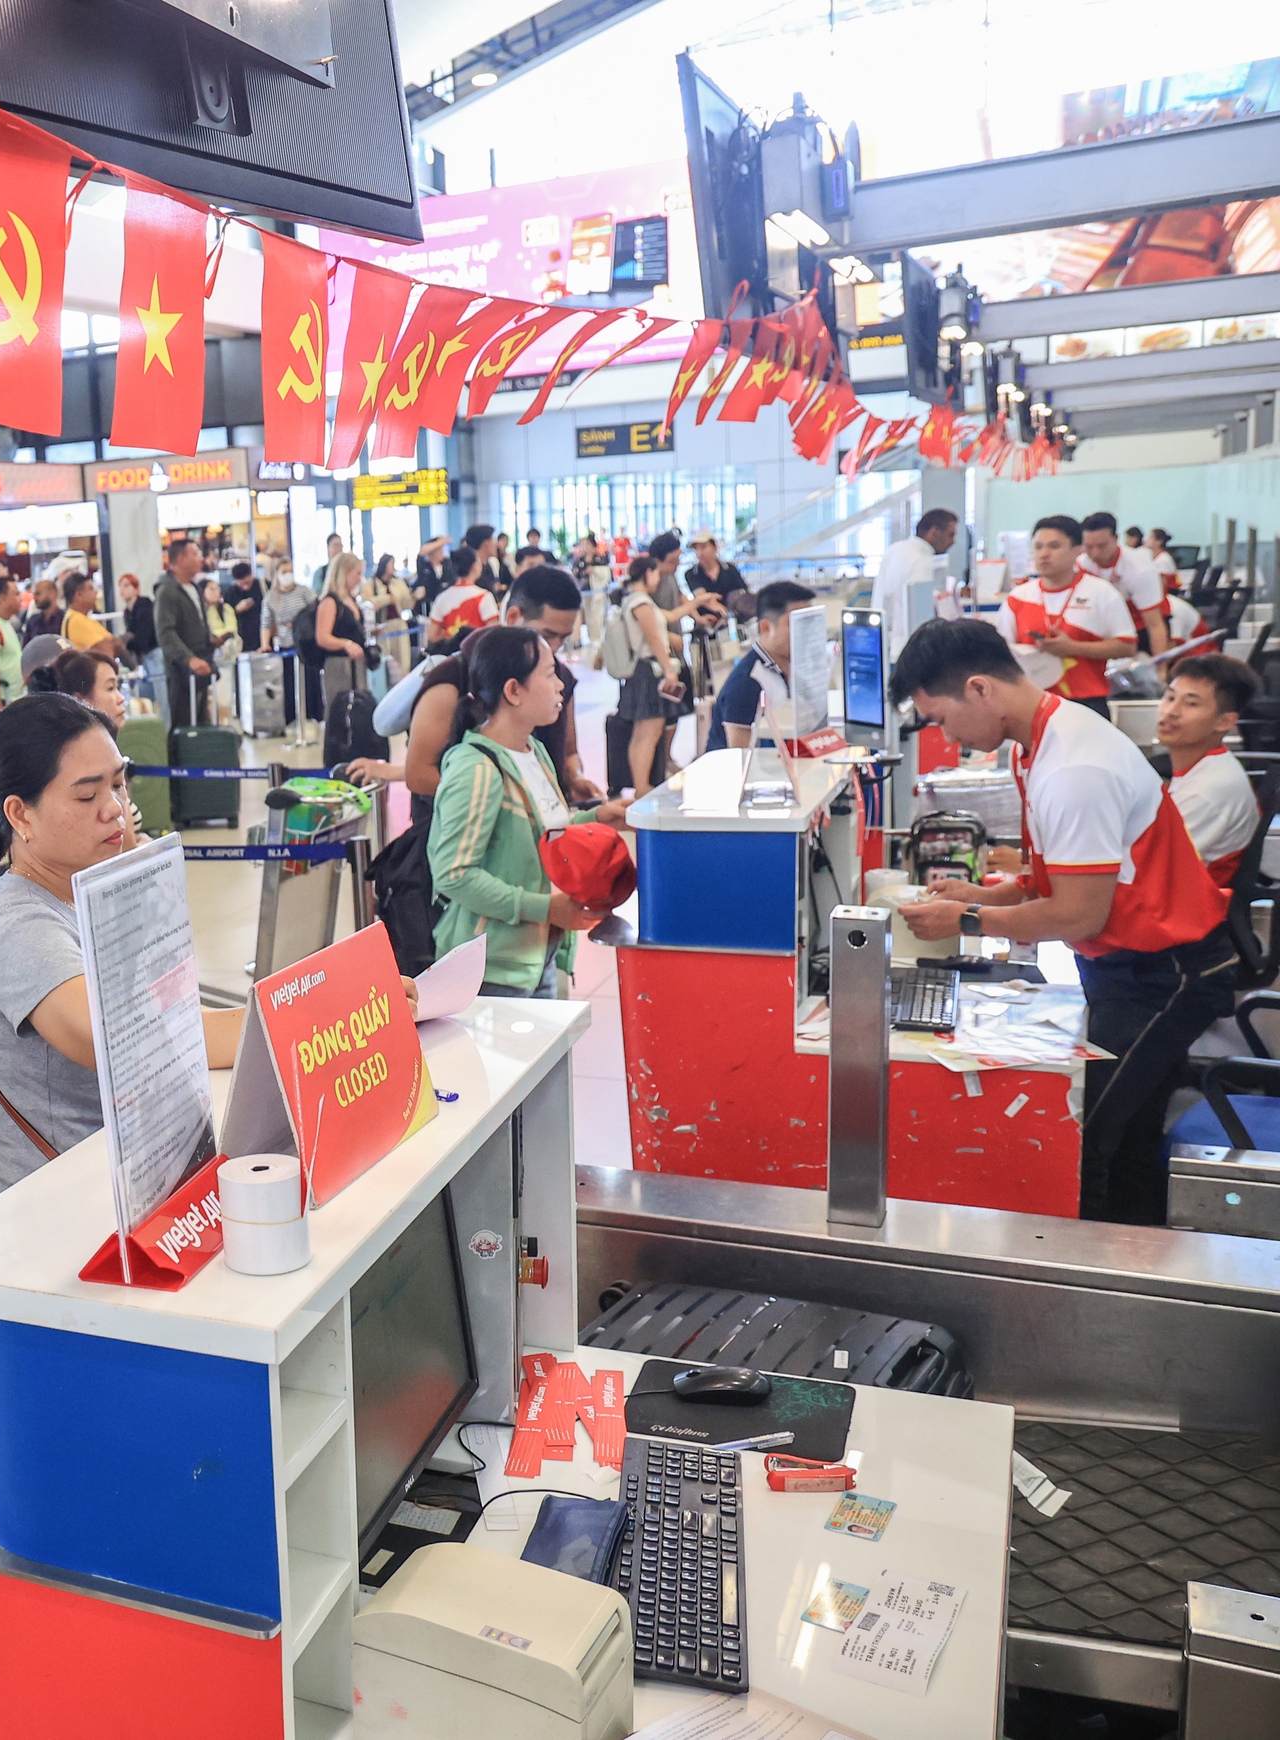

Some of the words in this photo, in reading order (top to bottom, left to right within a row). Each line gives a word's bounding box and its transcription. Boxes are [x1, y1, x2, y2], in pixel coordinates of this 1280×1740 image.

[629, 423, 652, 452] E
[95, 466, 151, 492] FOOD
[168, 459, 233, 485] DRINK
[206, 849, 245, 858] AIRPORT
[297, 1019, 352, 1075] ĐÓNG
[349, 985, 391, 1049] QUẦY
[334, 1052, 388, 1108] CLOSED
[899, 1663, 909, 1675] DA
